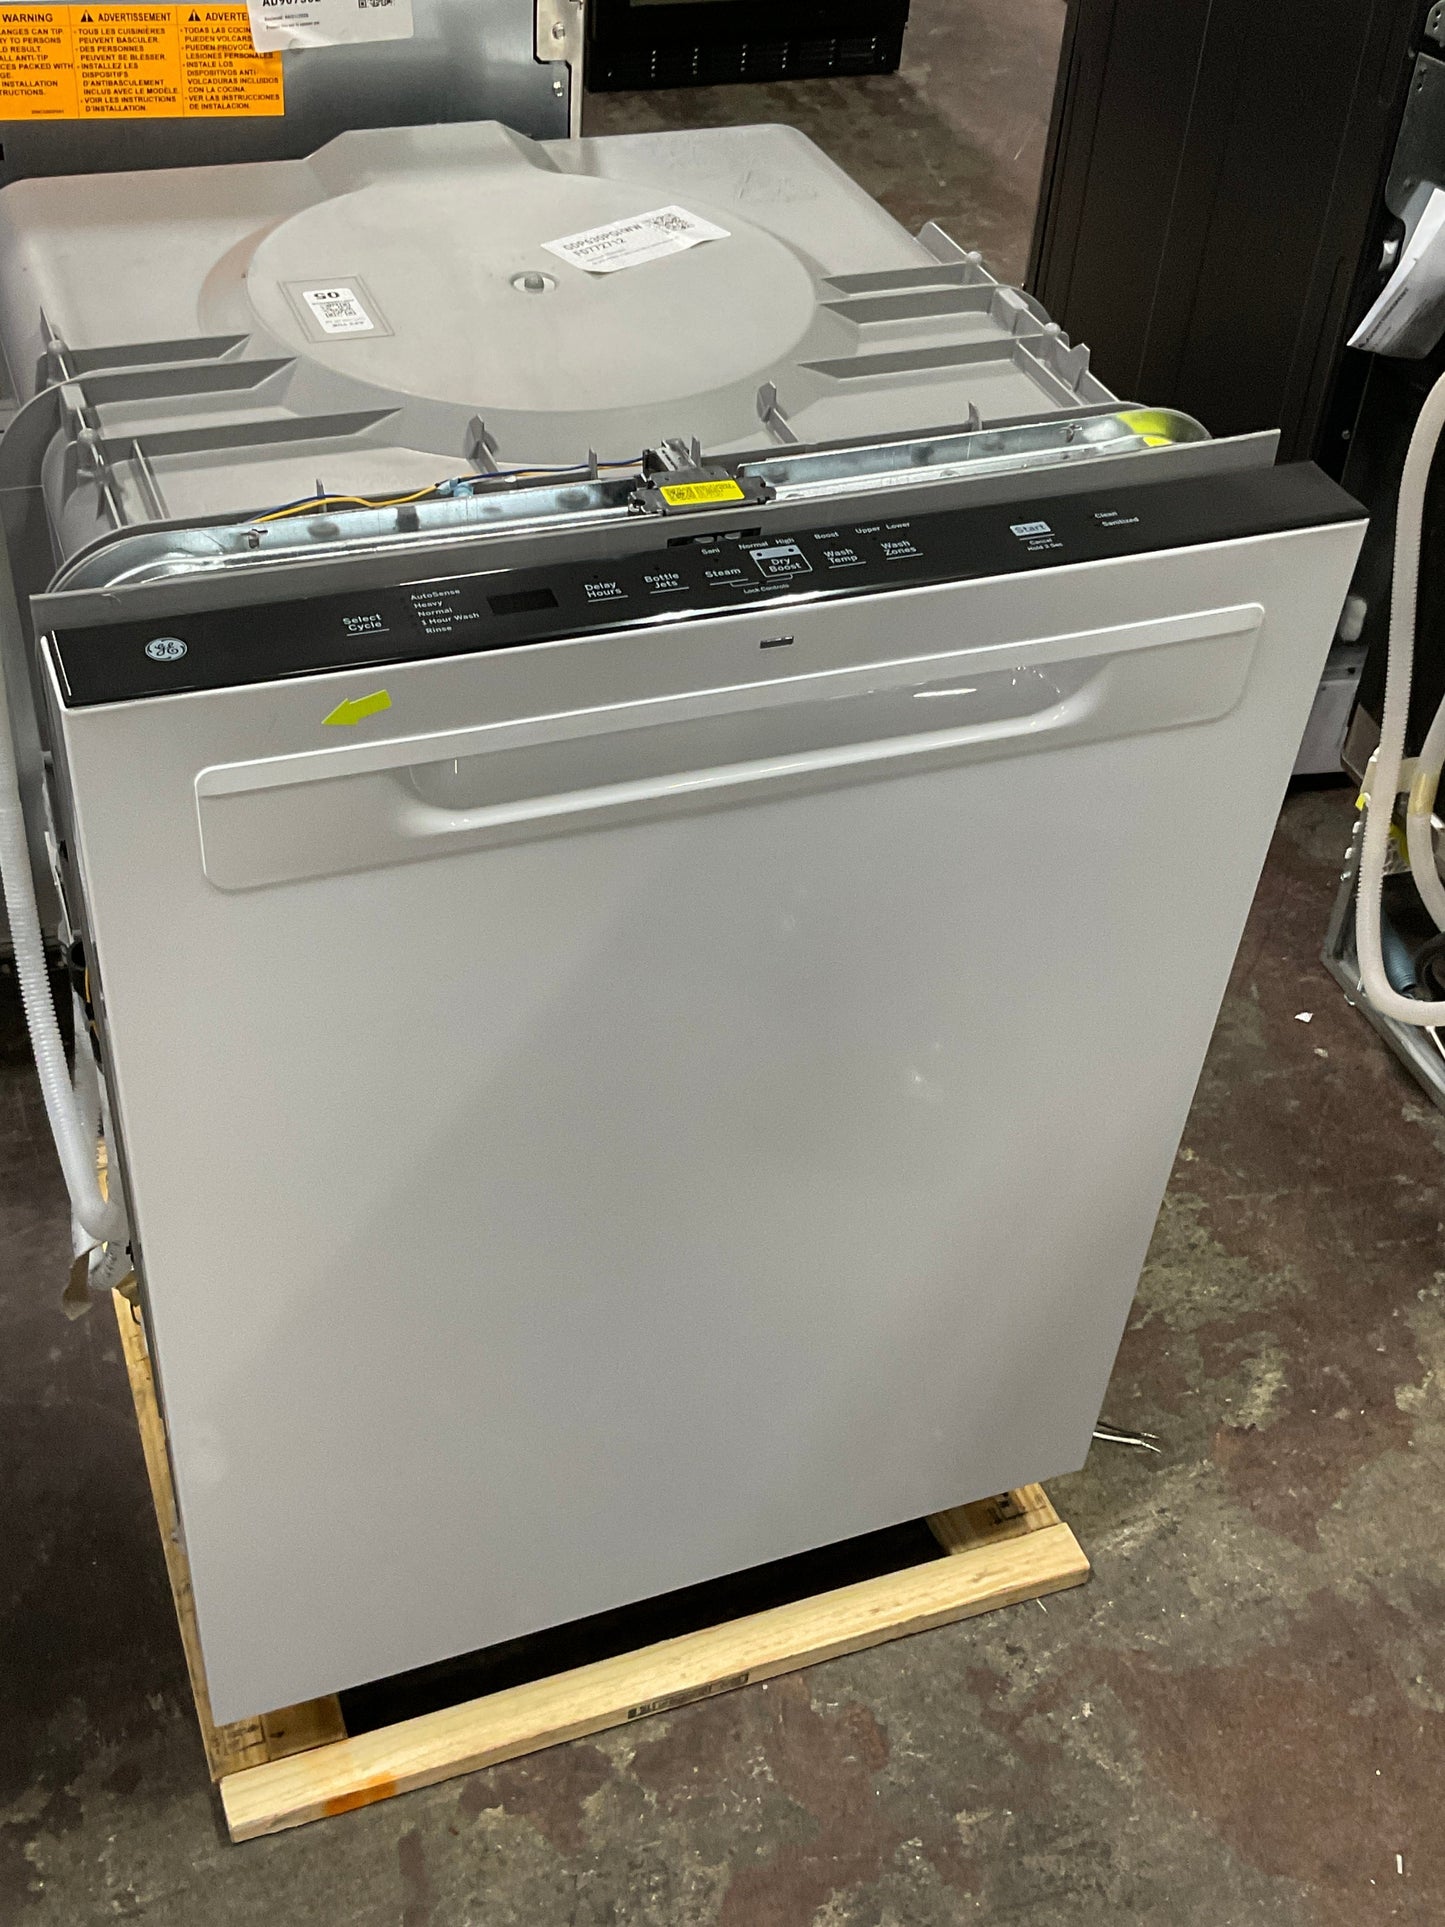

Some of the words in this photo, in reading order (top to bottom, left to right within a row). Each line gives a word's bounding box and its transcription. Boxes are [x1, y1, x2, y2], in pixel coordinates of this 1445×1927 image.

[2, 13, 53, 22] WARNING
[98, 12, 171, 21] ADVERTISSEMENT
[206, 12, 250, 21] ADVERTE
[855, 526, 881, 535] Upper
[885, 521, 910, 530] Lower
[1014, 524, 1047, 534] Start
[814, 531, 840, 540] Boost
[738, 540, 769, 550] Normal
[775, 537, 795, 545] High
[881, 540, 910, 550] Wash
[823, 548, 853, 558] Wash
[886, 547, 917, 556] Zones
[771, 557, 791, 566] Dry
[828, 555, 858, 564] Temp
[768, 562, 802, 573] Boost
[644, 572, 680, 584] Bottle
[705, 567, 741, 579] Steam
[585, 581, 617, 592] Delay
[654, 579, 678, 589] Jets
[410, 589, 460, 601] AutoSense
[587, 587, 622, 598] Hours
[413, 600, 442, 609] Heavy
[418, 607, 453, 617] Normal
[342, 613, 382, 625] Select
[429, 617, 452, 625] Hour
[454, 612, 480, 621] Wash
[348, 621, 382, 632] Cycle
[425, 626, 452, 634] Rinse
